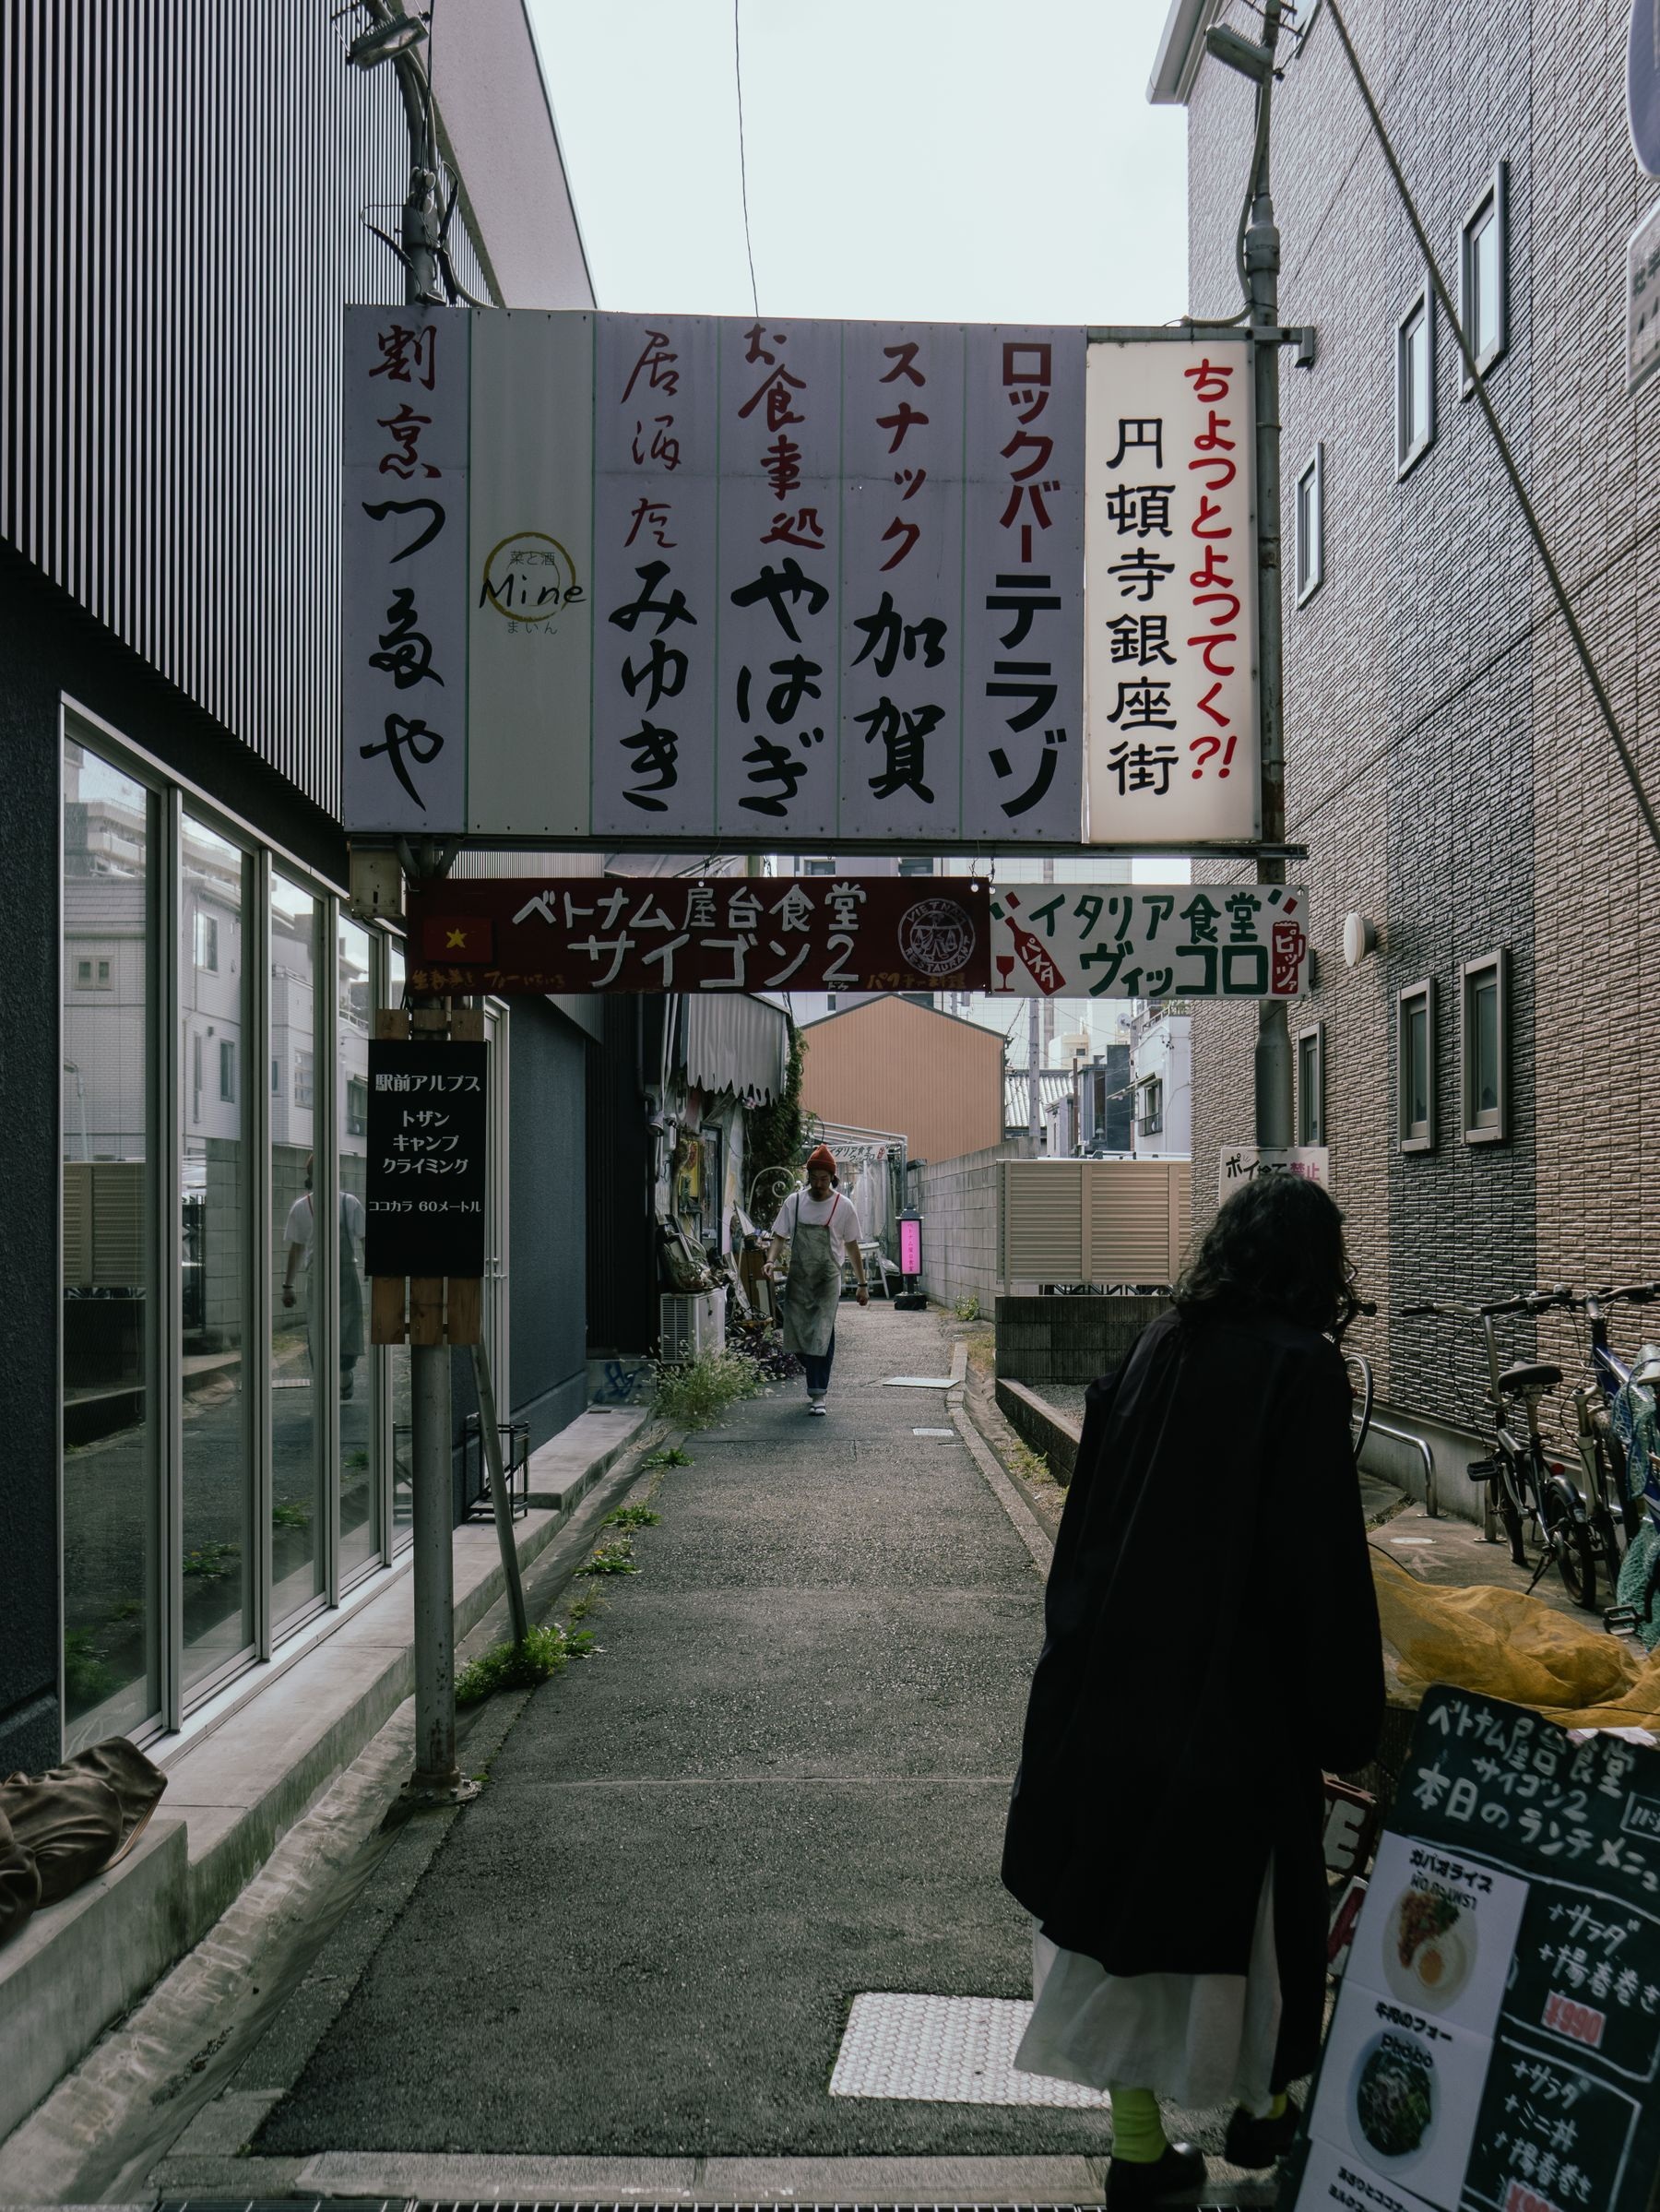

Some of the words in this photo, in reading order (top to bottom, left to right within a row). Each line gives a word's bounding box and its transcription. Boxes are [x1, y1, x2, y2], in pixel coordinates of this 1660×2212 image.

[510, 551, 556, 566] 菜と酒
[478, 573, 587, 609] Mine
[1106, 417, 1180, 797] 円頓寺銀座街
[507, 621, 559, 635] まいん
[512, 882, 867, 931] ベトナム屋台食堂
[1028, 891, 1263, 945] イタリア食堂
[566, 930, 860, 988] サイゴン2
[1079, 940, 1268, 997] ヴィッコロ
[865, 971, 966, 990] パクチー料理
[375, 1074, 481, 1092] 駅前アルプス
[402, 1110, 450, 1128] トザン
[393, 1134, 460, 1152] キャンプ
[383, 1158, 468, 1174] クライミング
[369, 1201, 413, 1213] ココカラ
[419, 1201, 482, 1213] 60メートル
[1427, 1700, 1637, 1800] ベトナム屋台食堂
